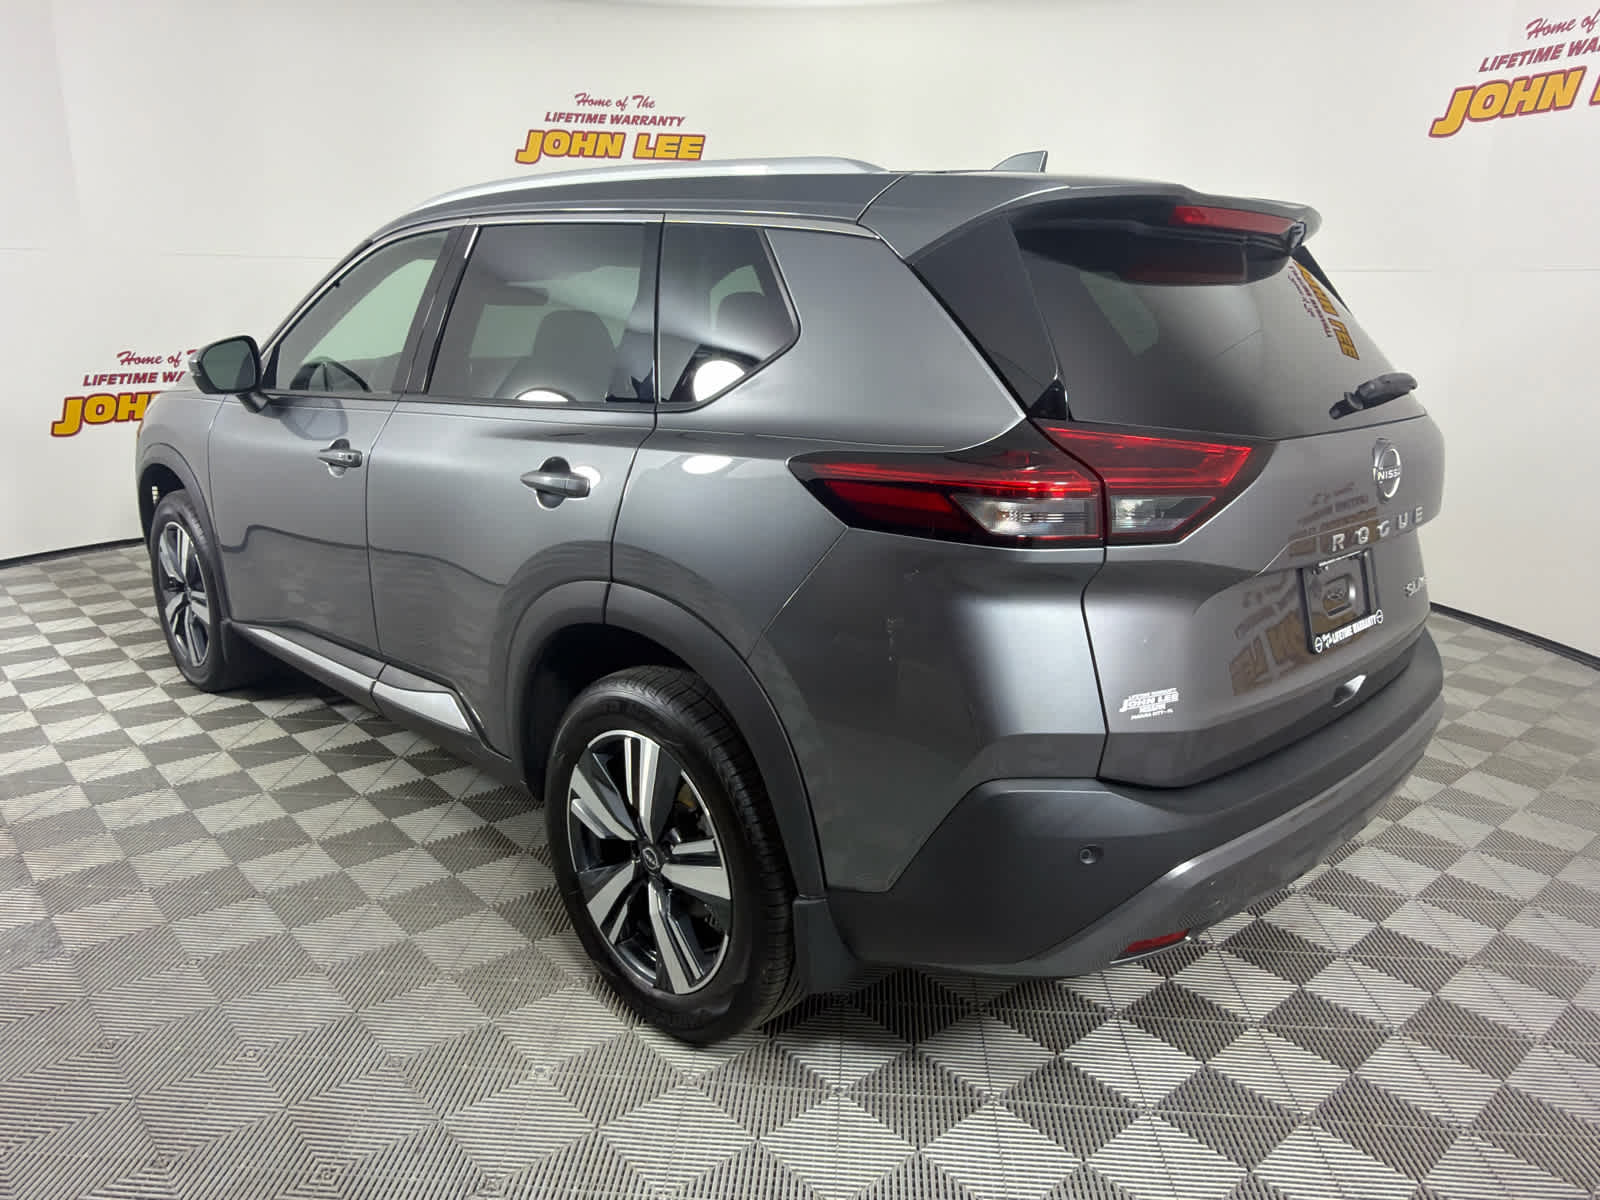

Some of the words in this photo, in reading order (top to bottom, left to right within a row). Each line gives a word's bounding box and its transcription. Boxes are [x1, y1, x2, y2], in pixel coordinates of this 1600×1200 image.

[1525, 17, 1577, 40] Home
[1478, 43, 1566, 72] LIFETIME
[574, 92, 613, 108] Home
[615, 96, 629, 110] of
[631, 94, 656, 109] The
[1428, 65, 1587, 138] JOHN
[544, 112, 607, 124] LIFETIME
[610, 114, 686, 127] WARRANTY
[515, 129, 626, 164] JOHN
[632, 133, 706, 160] LEE
[117, 350, 164, 366] Home
[167, 351, 182, 367] of
[83, 373, 158, 387] LIFETIME
[51, 391, 161, 437] JOH
